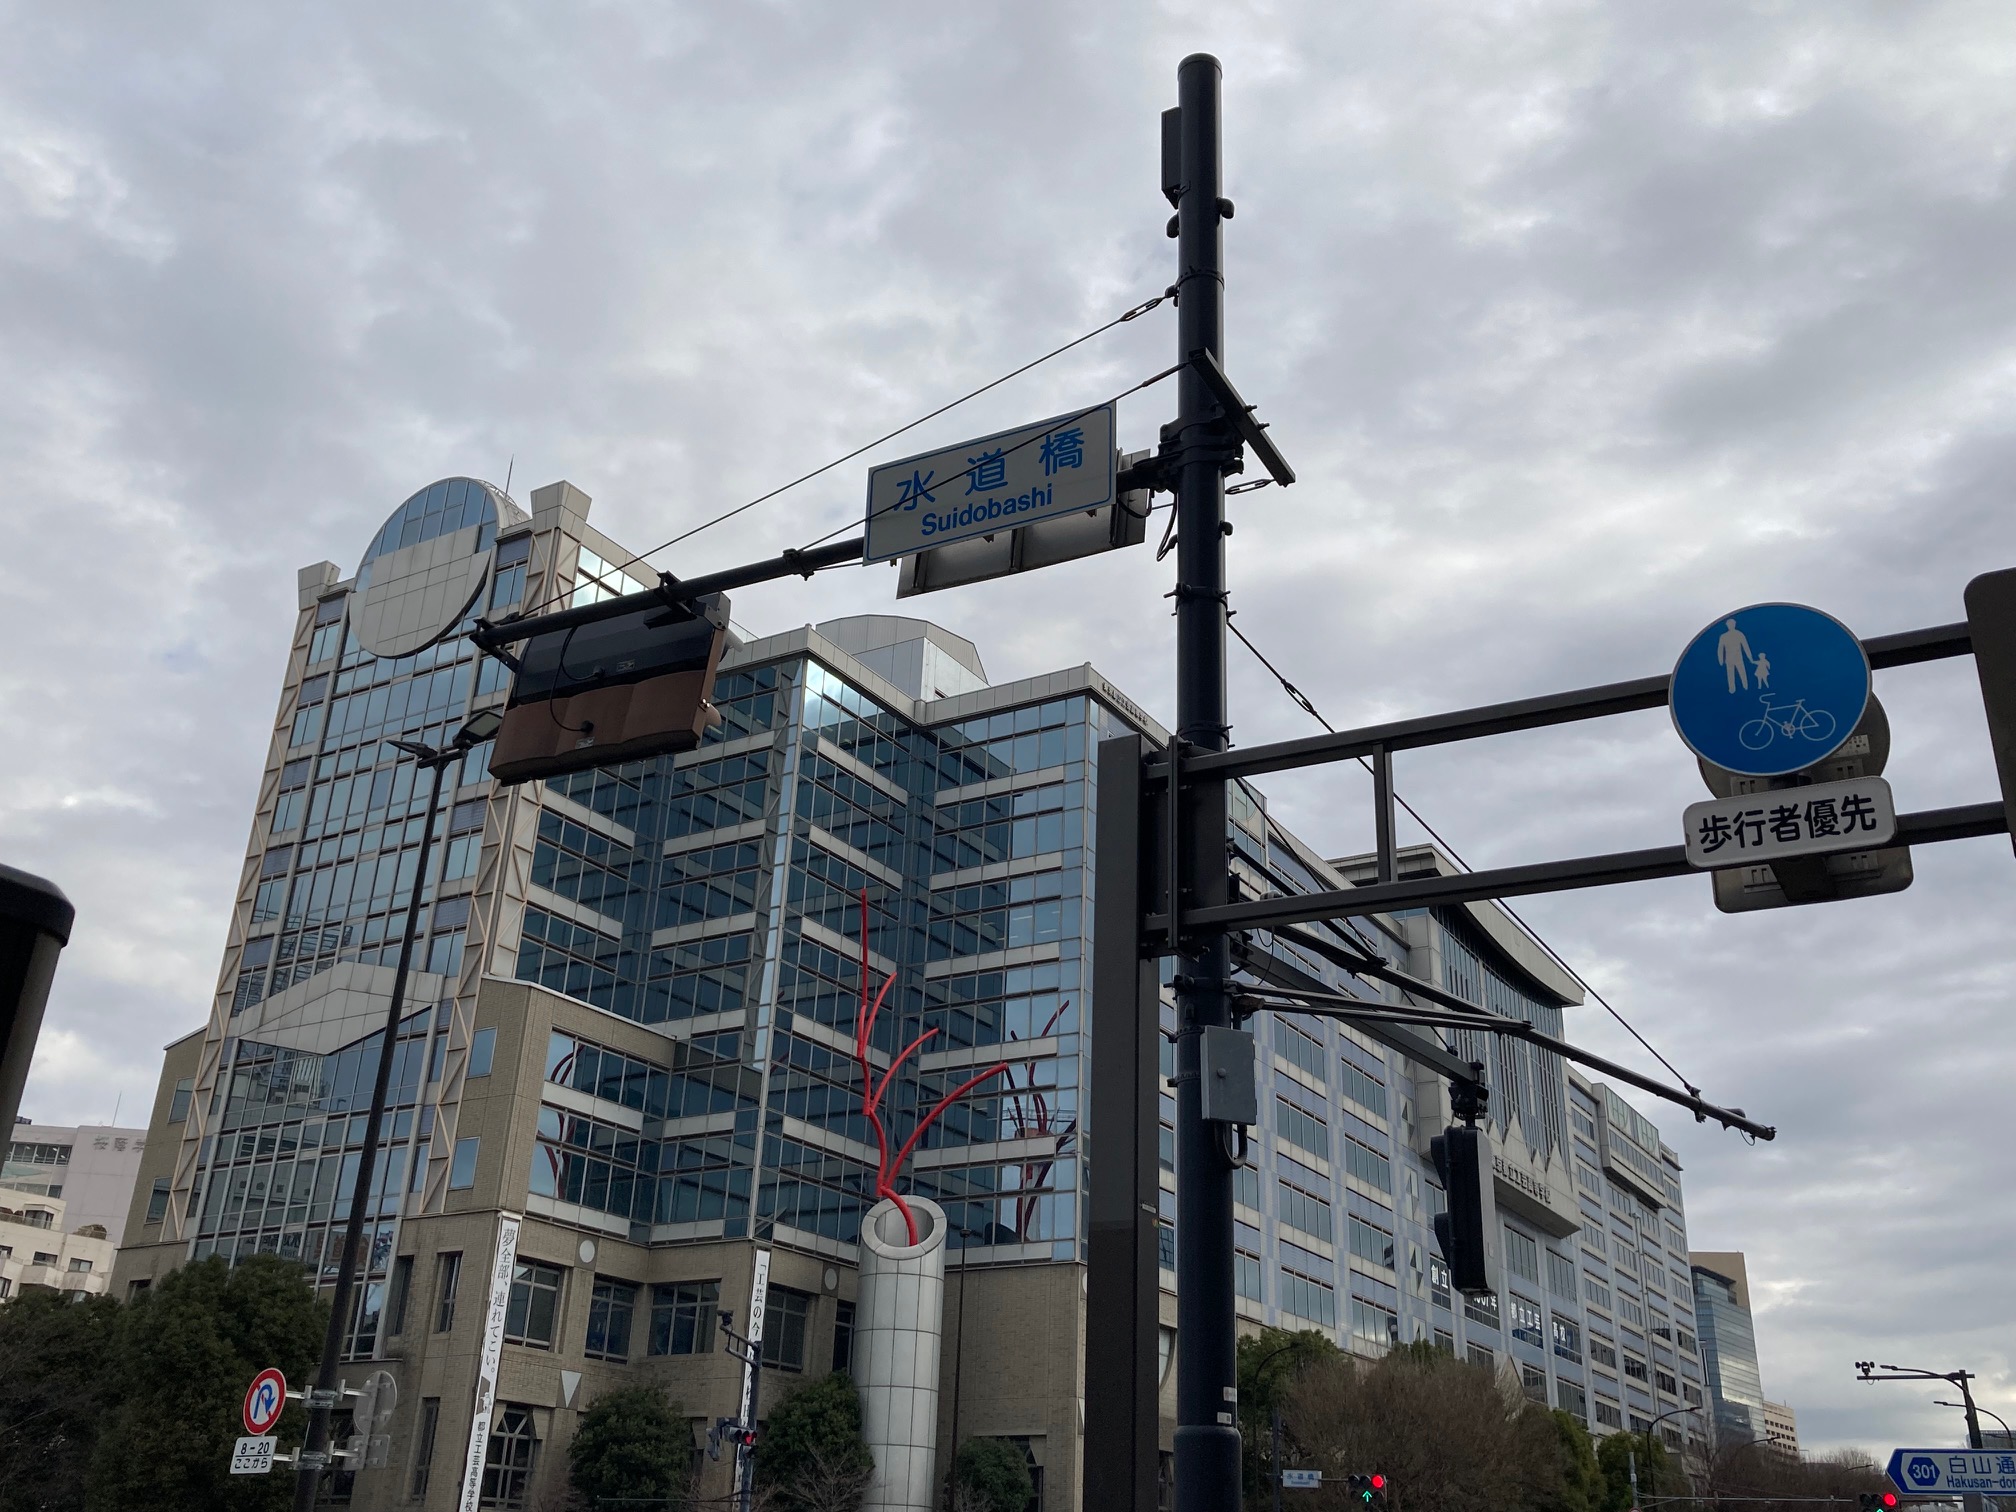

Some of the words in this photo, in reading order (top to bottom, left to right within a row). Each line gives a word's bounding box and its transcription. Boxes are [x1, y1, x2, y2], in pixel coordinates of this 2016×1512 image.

[894, 427, 1084, 511] 水道橋
[921, 484, 1053, 535] Suidobashi
[1699, 794, 1877, 853] 歩行者優先
[485, 1228, 516, 1373] 夢全部、連れてこい。
[234, 1457, 268, 1469] ここから
[465, 1421, 486, 1512] 都立工芸高等学校
[1912, 1465, 1937, 1479] 301
[1949, 1456, 2016, 1475] 白山通
